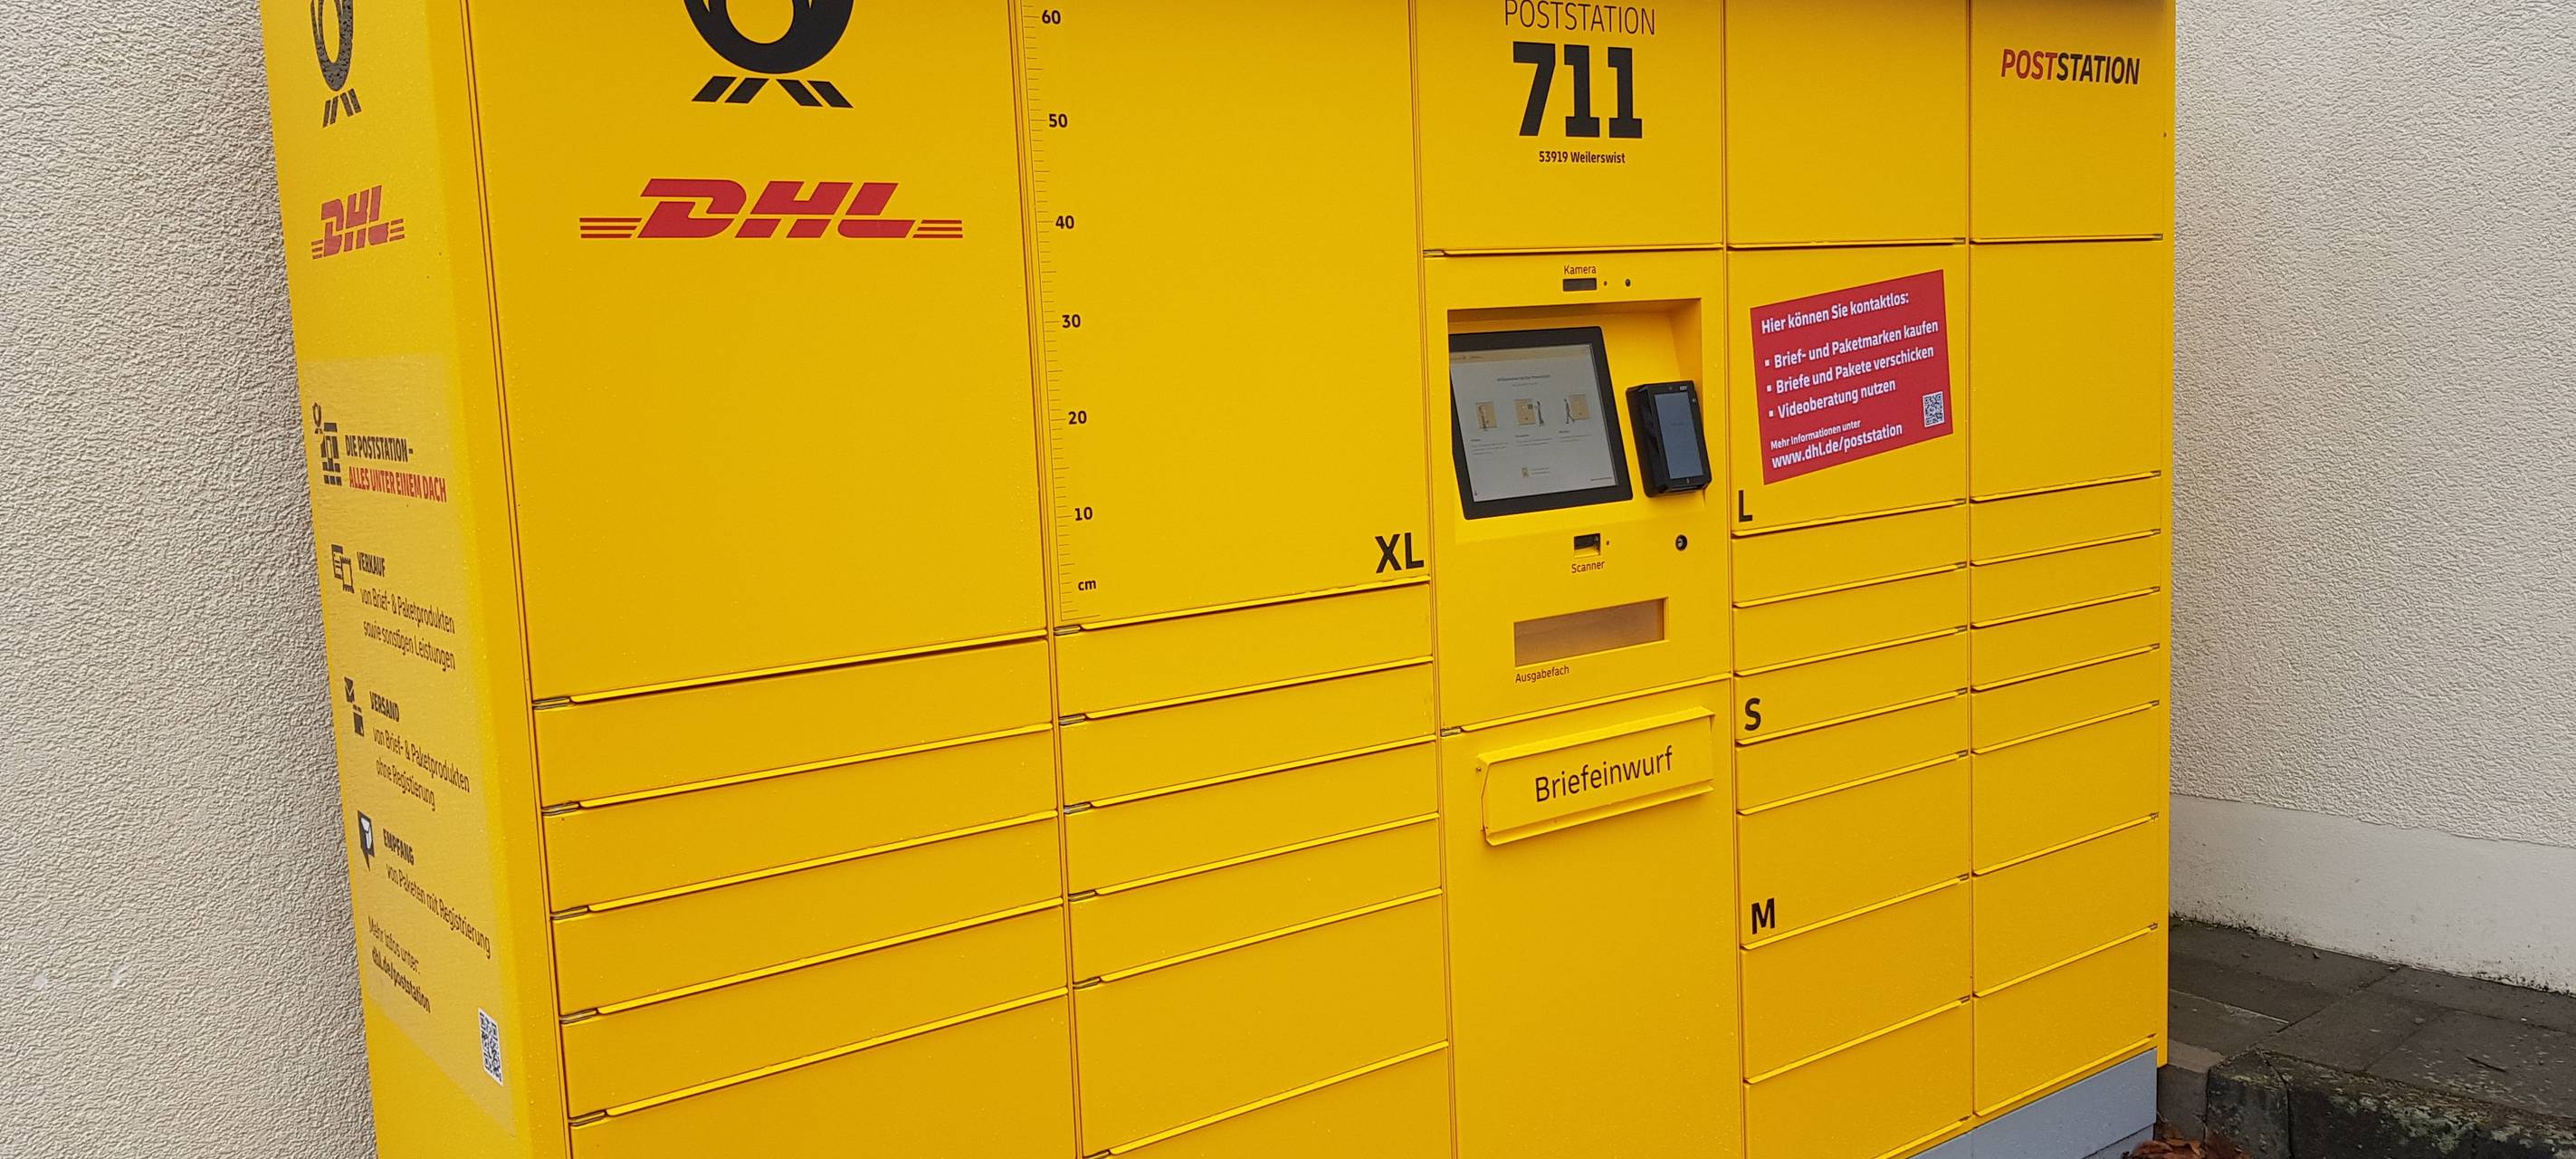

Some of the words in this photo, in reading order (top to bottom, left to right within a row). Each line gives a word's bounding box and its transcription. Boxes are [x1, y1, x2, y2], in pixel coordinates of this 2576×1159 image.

[1041, 10, 1062, 25] 60
[1505, 0, 1655, 35] POSTSTATION
[2000, 48, 2141, 85] POSTSTATION
[1512, 41, 1643, 139] 711
[1048, 113, 1068, 129] 50
[1539, 150, 1569, 163] 53919
[1570, 151, 1626, 164] Weilerswist
[321, 185, 389, 258] DHL
[637, 178, 916, 239] DHL
[1054, 215, 1075, 230] 40
[1563, 264, 1597, 275] Kamera
[1061, 314, 1082, 329] 30
[1760, 317, 1786, 334] Hier
[1788, 310, 1829, 329] können
[1831, 303, 1848, 320] Sie
[1850, 292, 1909, 315] kontaktlos:
[1774, 349, 1807, 369] Brief-
[1808, 342, 1830, 361] und
[1831, 329, 1902, 355] Paketmarken
[1903, 319, 1939, 340] kaufen
[1776, 373, 1810, 394] Briefe
[1812, 367, 1834, 387] und
[1835, 358, 1872, 379] Pakete
[1873, 344, 1934, 370] verschicken
[1778, 387, 1859, 419] Videoberatung
[1860, 378, 1896, 398] nutzen
[1068, 410, 1087, 425] 20
[1770, 436, 1790, 451] Mehr
[1791, 425, 1842, 445] Informationen
[1843, 419, 1862, 433] unter
[345, 435, 358, 457] DIE
[358, 436, 408, 463] POSTSTATION
[1771, 422, 1903, 469] www.dhl.de/poststation
[349, 466, 370, 490] ALLES
[370, 469, 396, 494] UNTER
[396, 472, 422, 498] EINEM
[422, 476, 447, 503] DACH
[1074, 507, 1093, 522] 10
[1739, 490, 1752, 522] L
[357, 551, 386, 578] VERKAUF
[1374, 532, 1425, 574] XL
[1571, 559, 1605, 574] Scanner
[1077, 579, 1097, 591] cm
[398, 596, 455, 635] Paketprodukten
[382, 628, 414, 656] sonstigen
[415, 635, 455, 672] Leistungen
[1514, 665, 1570, 684] Ausgabefach
[369, 691, 400, 723] VERSAND
[1744, 697, 1761, 731] S
[411, 743, 470, 793] Paketprodukten
[1535, 744, 1674, 803] Briefeinwurf
[383, 829, 415, 866] EMPFANG
[1751, 897, 1775, 934] M
